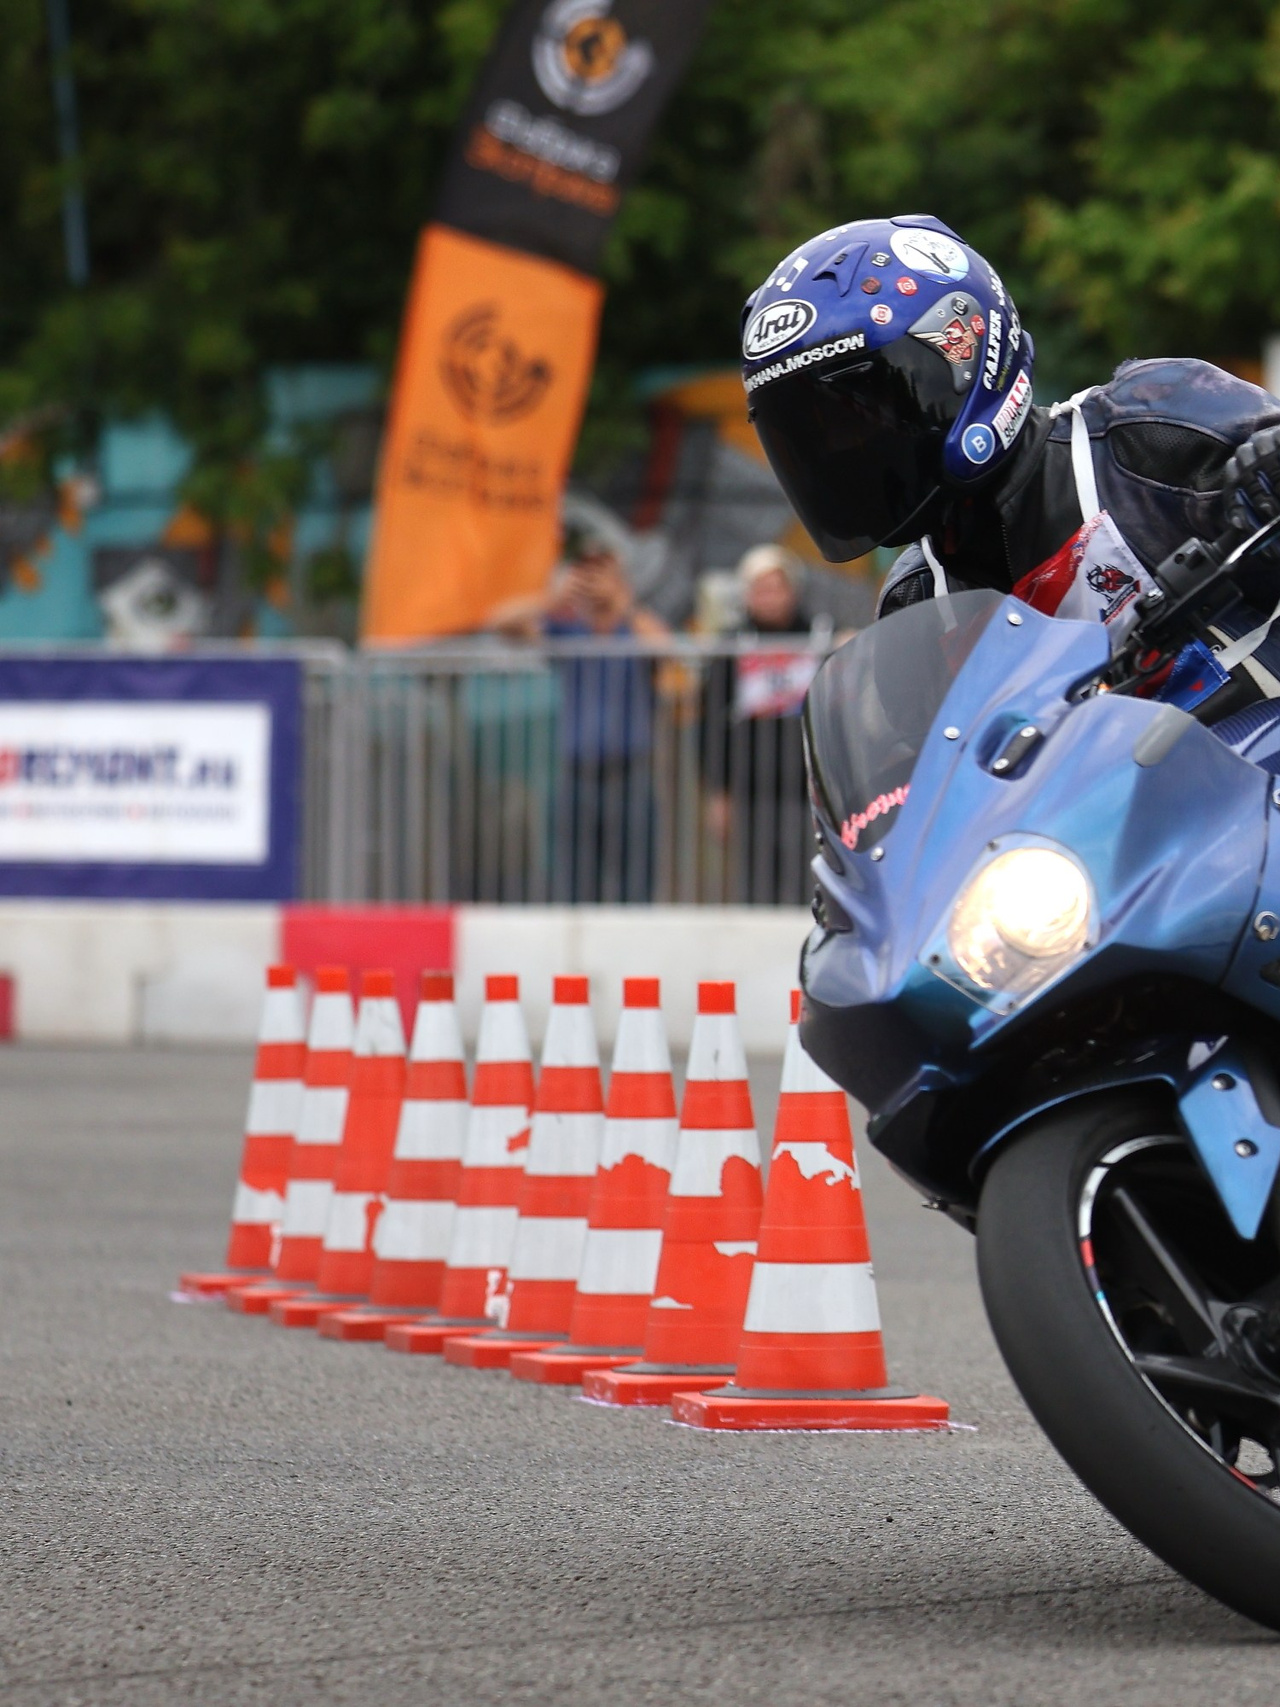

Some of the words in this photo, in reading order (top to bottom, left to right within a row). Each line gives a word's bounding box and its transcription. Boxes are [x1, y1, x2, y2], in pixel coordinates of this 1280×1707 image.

[749, 304, 802, 348] Arai
[983, 309, 1002, 390] GALFER
[971, 435, 987, 453] B
